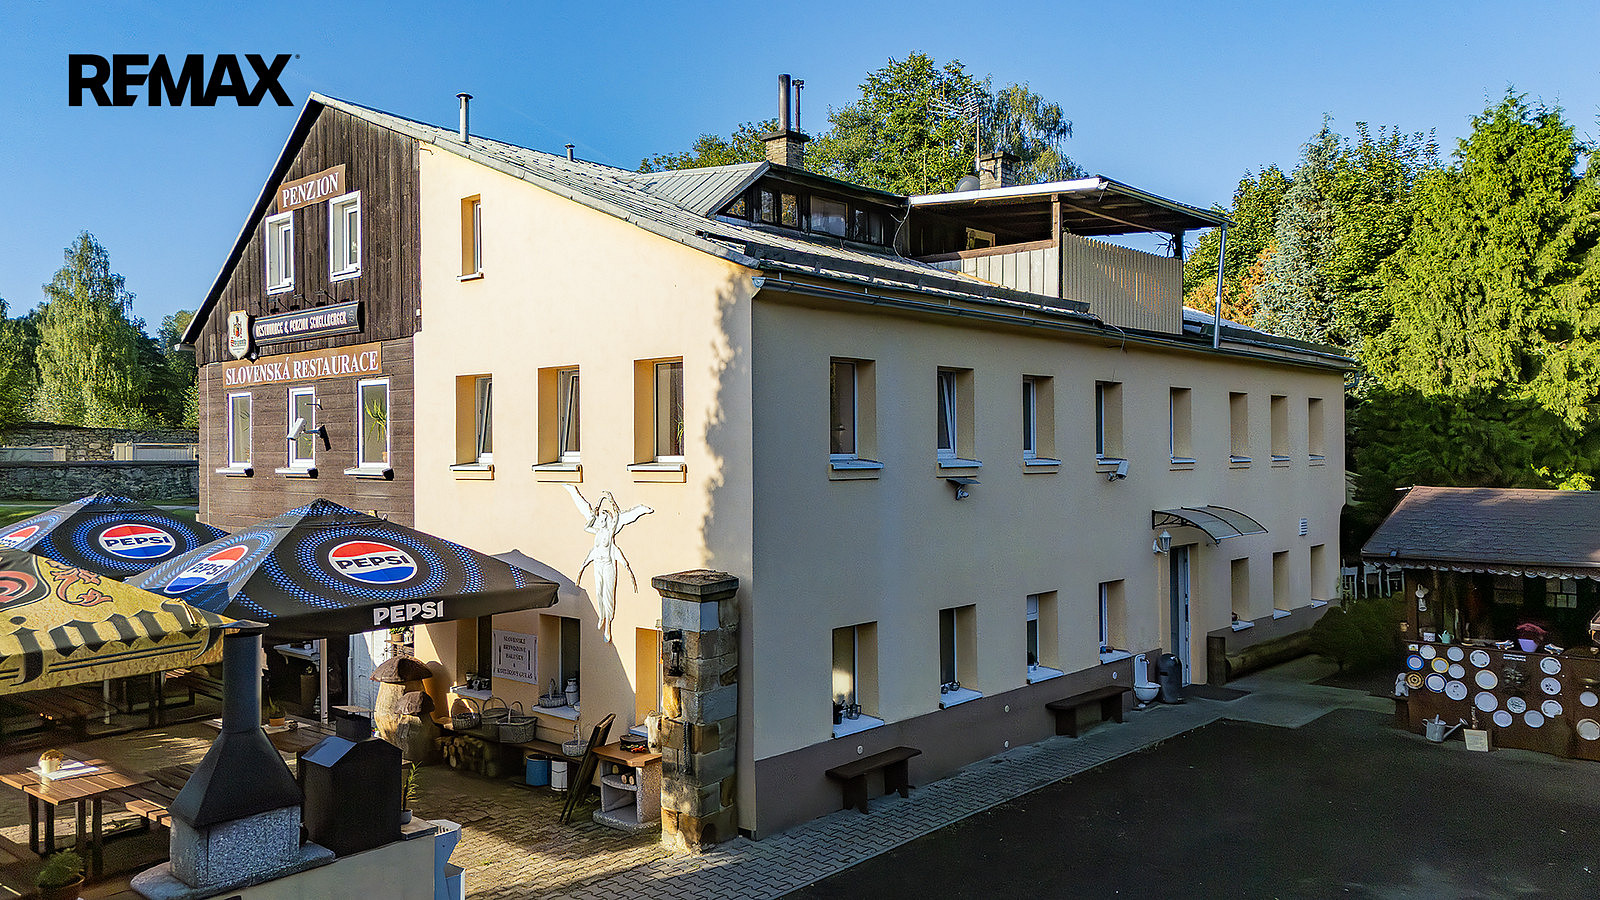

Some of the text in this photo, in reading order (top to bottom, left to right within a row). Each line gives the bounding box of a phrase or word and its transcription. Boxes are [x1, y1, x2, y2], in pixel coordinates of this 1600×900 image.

[282, 172, 339, 208] PENZION
[225, 351, 379, 386] SLOVENSKÁ RESTAURACE
[104, 536, 171, 548] PEPSI
[186, 562, 229, 576] PEPSI
[336, 555, 410, 570] PEPSI
[373, 600, 445, 626] PEPSI
